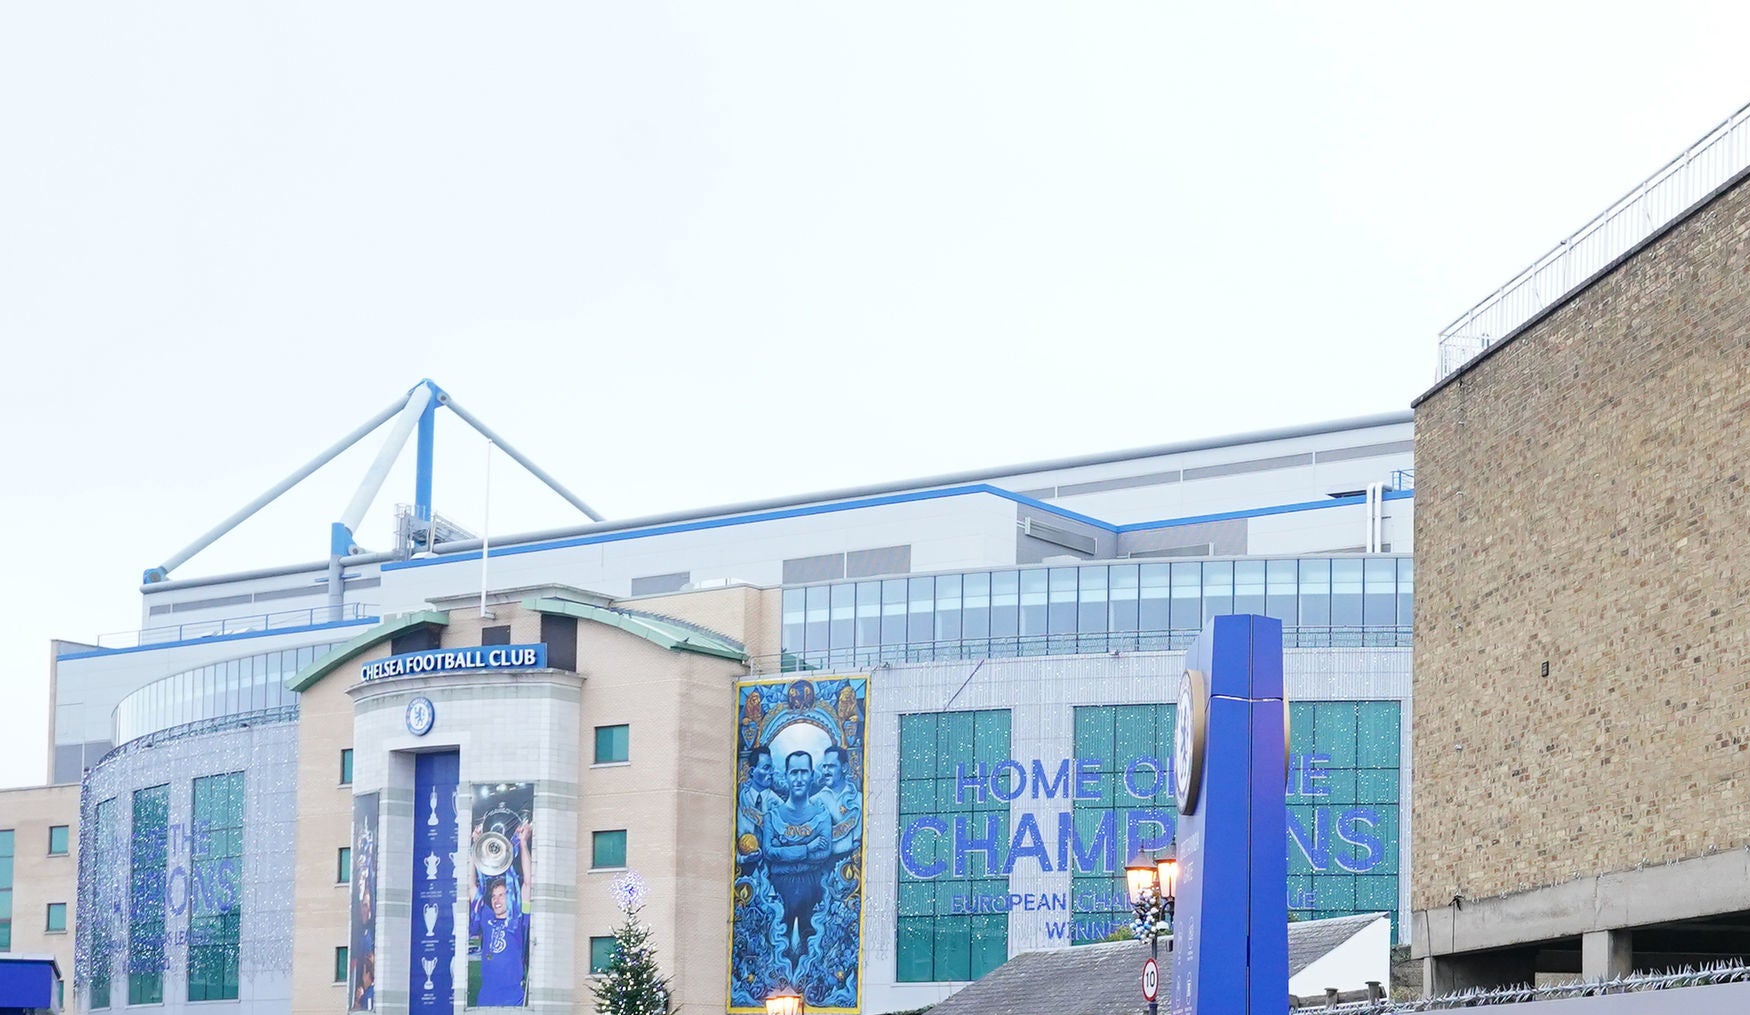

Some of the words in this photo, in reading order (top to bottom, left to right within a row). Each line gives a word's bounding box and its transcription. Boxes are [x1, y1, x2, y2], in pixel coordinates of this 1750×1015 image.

[361, 659, 404, 681] CHELSEA
[406, 651, 486, 673] FOOTBALL
[488, 649, 536, 667] CLUB
[955, 757, 1101, 804] HOME
[1124, 755, 1175, 800] O
[951, 892, 1067, 914] EUROPEAN
[1146, 971, 1154, 987] 10
